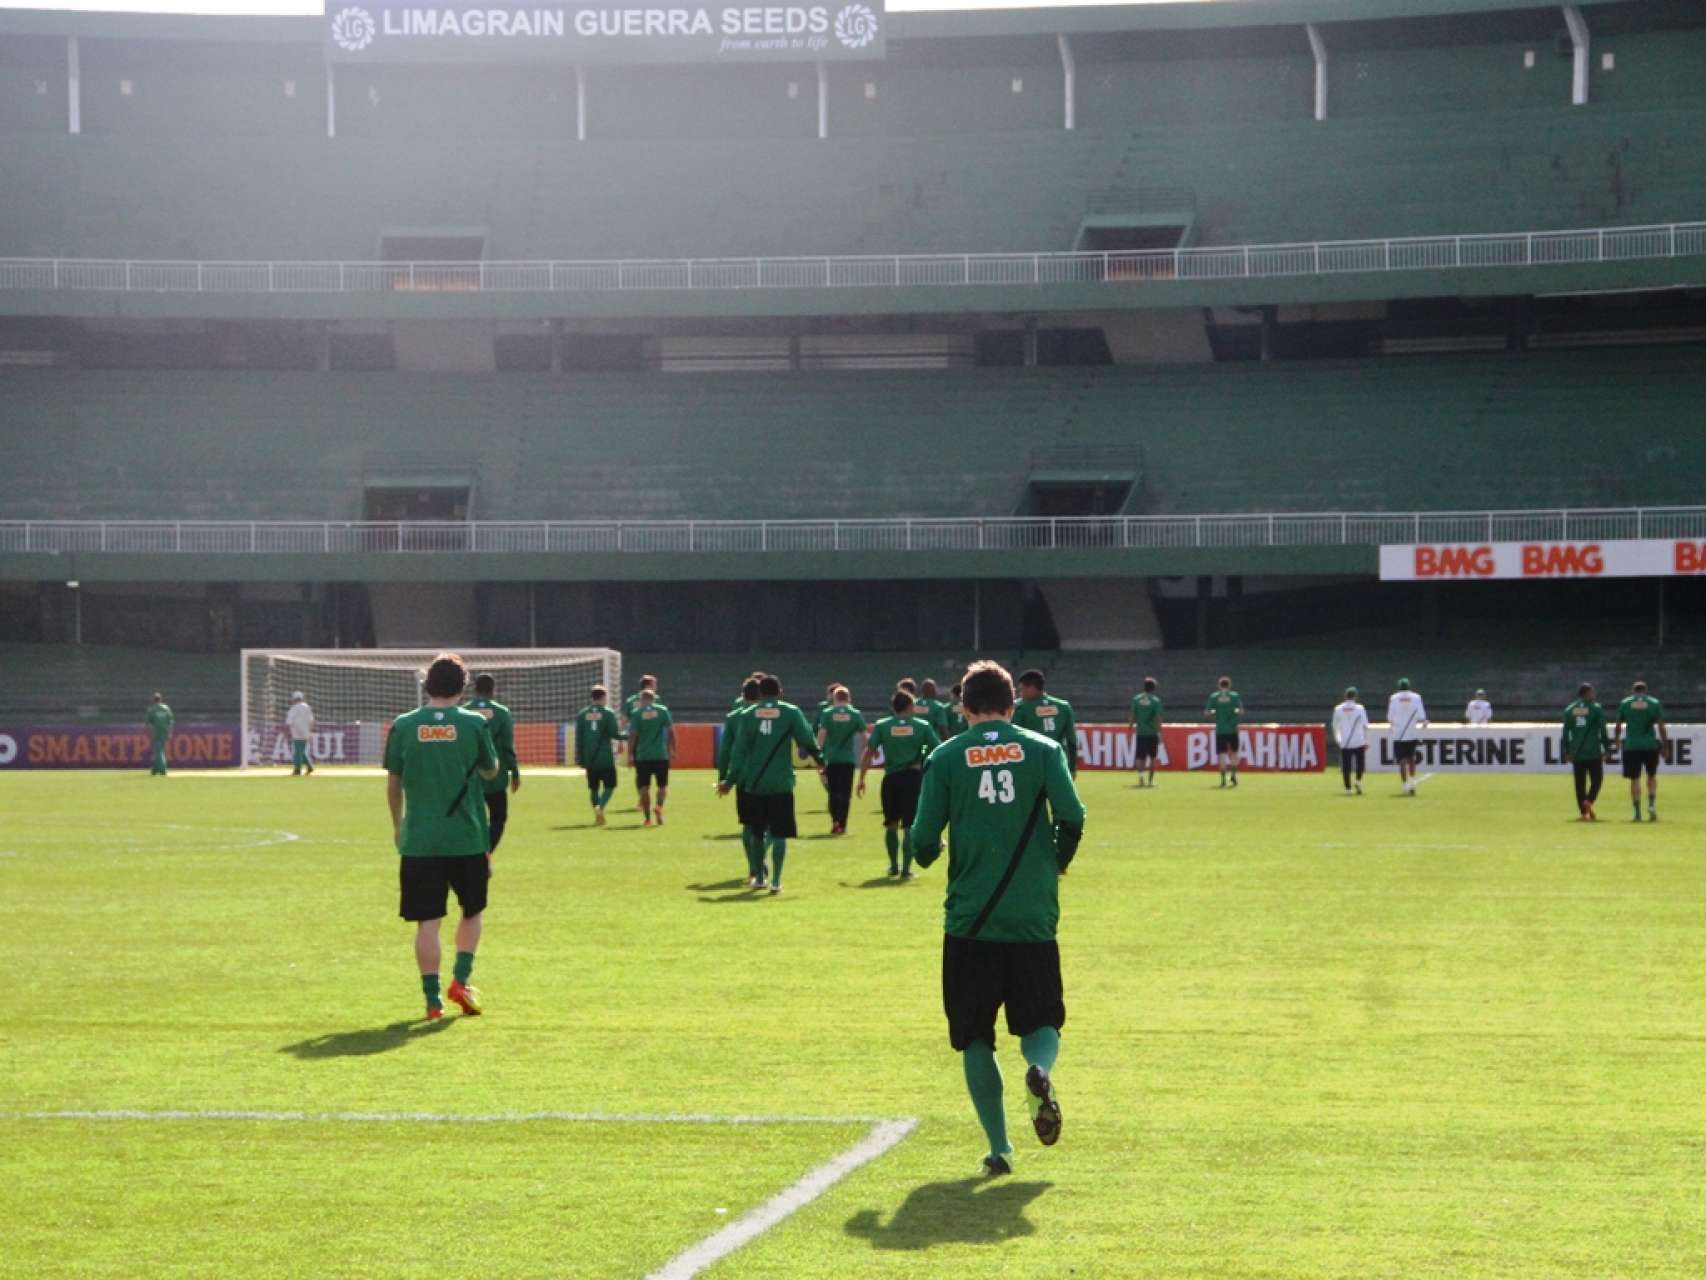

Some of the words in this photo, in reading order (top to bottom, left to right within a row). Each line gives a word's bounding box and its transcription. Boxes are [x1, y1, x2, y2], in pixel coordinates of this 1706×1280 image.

[383, 9, 564, 36] LIMAGRAIN
[574, 9, 713, 36] GUERRA
[721, 6, 829, 34] SEEDS
[720, 38, 752, 52] from
[755, 36, 788, 49] earth
[792, 37, 804, 49] to
[807, 35, 828, 50] life
[1414, 546, 1494, 577] BMG
[1521, 544, 1603, 575] BMG
[1674, 541, 1706, 573] B
[759, 719, 773, 735] 41
[271, 732, 345, 761] AUI
[967, 744, 1023, 765] BMG
[1380, 737, 1525, 766] LSTERINE
[978, 769, 1015, 804] 43
